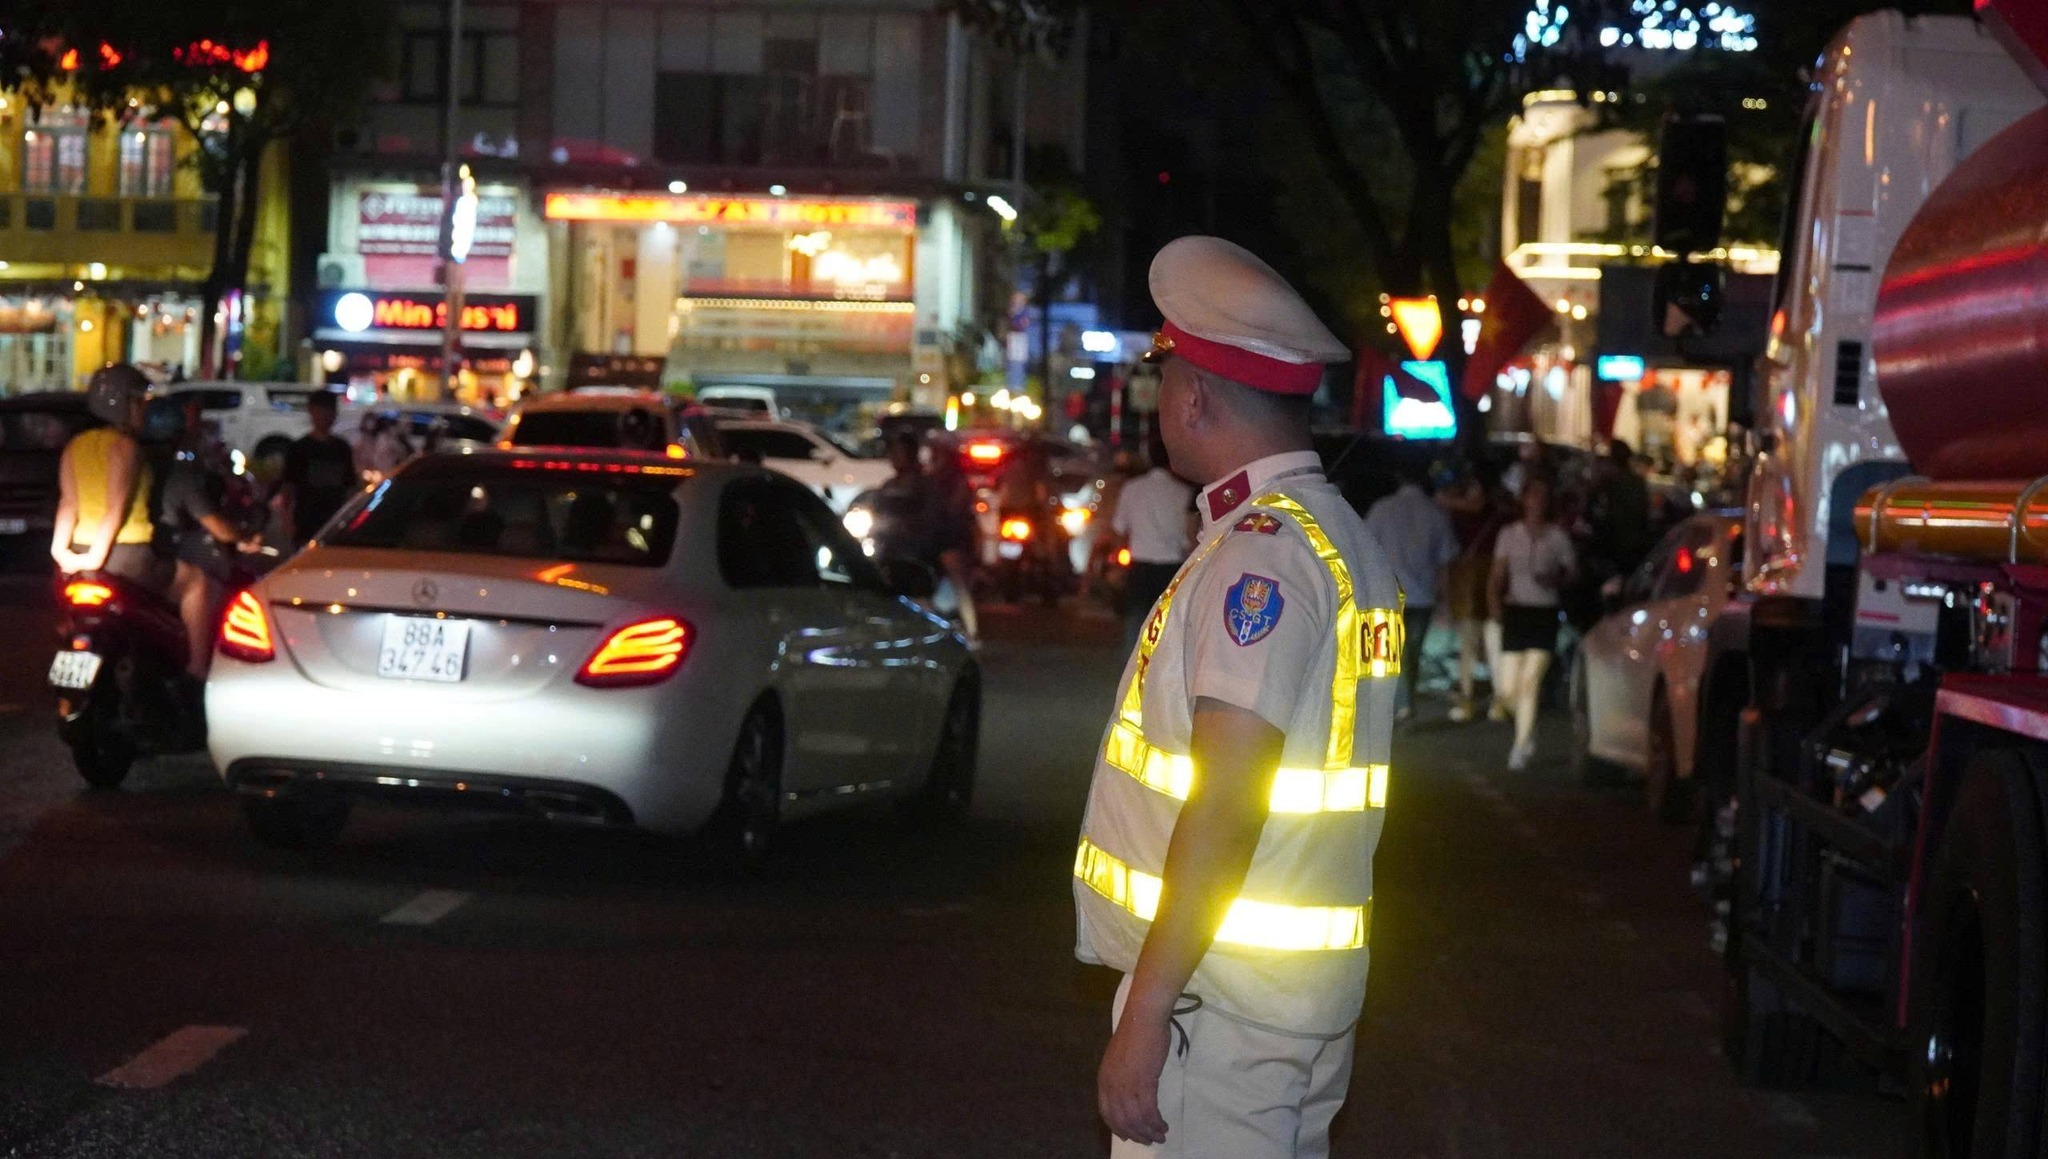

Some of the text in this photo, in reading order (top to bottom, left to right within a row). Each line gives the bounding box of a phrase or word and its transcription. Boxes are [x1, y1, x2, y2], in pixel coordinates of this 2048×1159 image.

[375, 299, 433, 328] Min
[1229, 608, 1272, 626] CSGT
[404, 621, 444, 647] 88A
